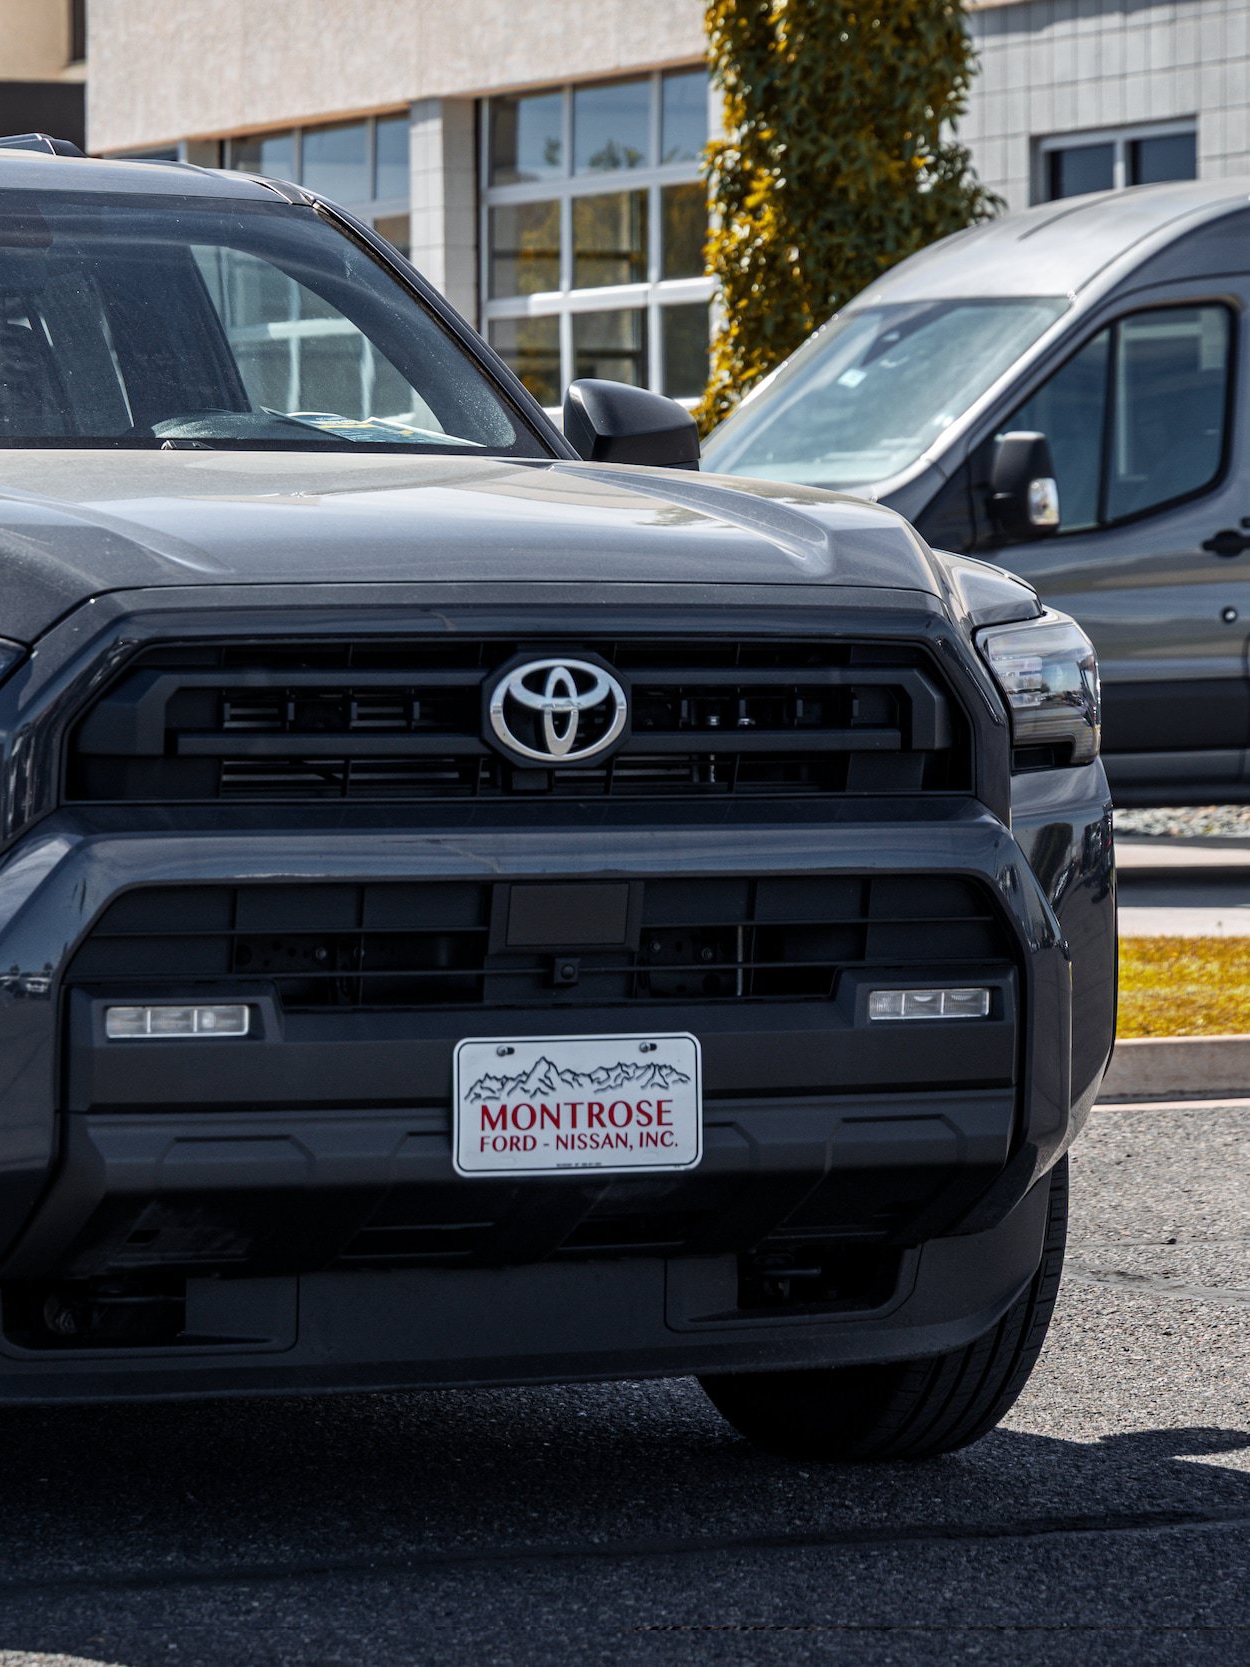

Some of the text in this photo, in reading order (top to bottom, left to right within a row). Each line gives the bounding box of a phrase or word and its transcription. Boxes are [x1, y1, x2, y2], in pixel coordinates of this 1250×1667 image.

[481, 1100, 673, 1131] MONTROSE
[480, 1135, 537, 1152] FORD
[556, 1132, 633, 1152] NISSAN,
[639, 1131, 678, 1147] INC.
